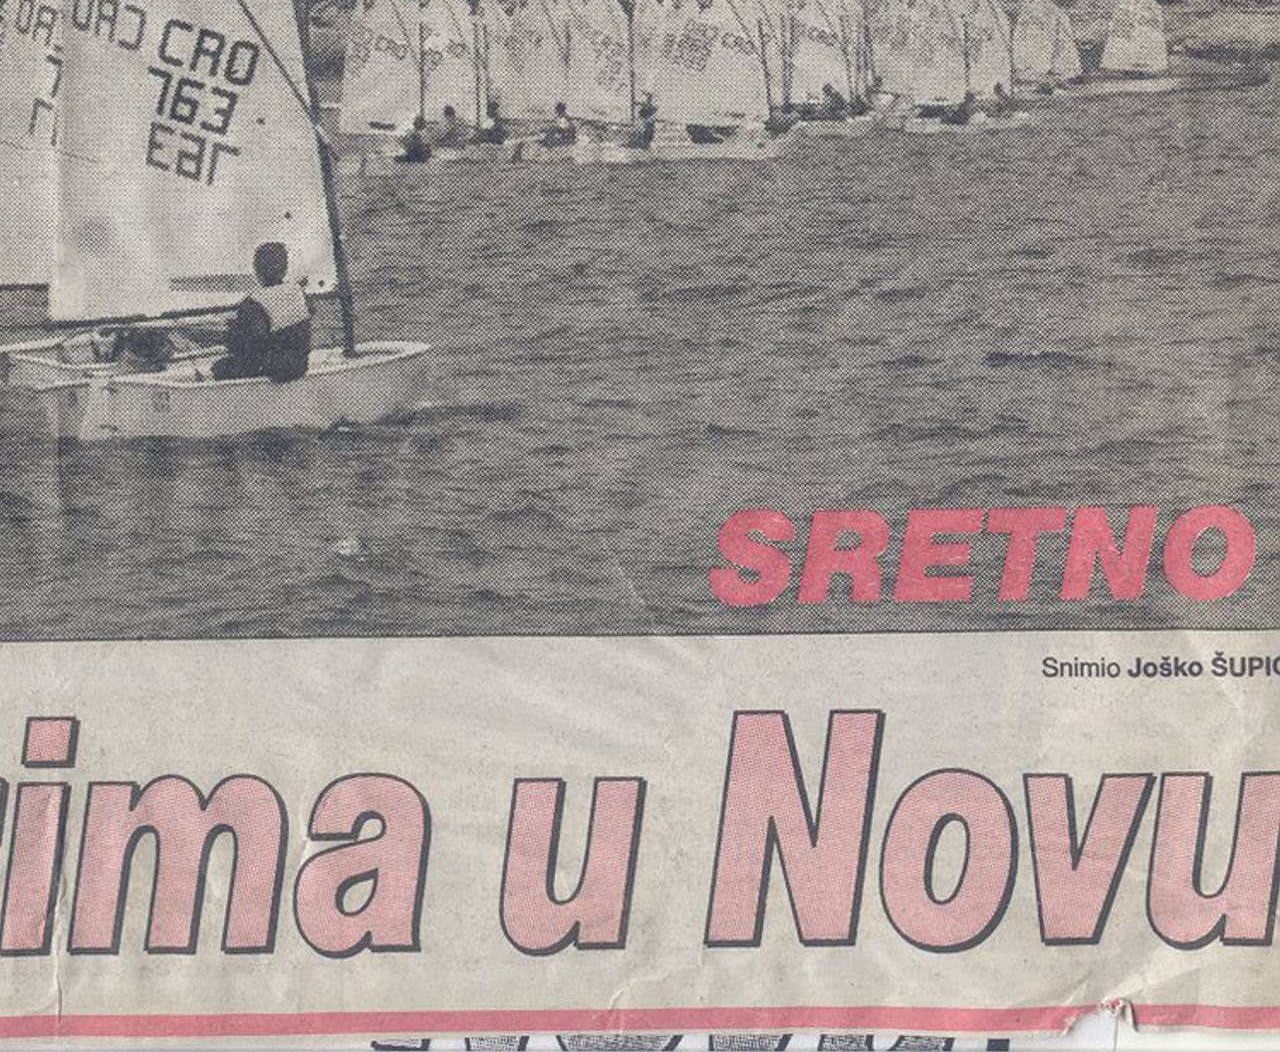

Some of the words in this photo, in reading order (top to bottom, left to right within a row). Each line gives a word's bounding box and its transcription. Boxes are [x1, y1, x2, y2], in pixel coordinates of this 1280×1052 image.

[158, 18, 262, 87] CRO
[147, 65, 240, 137] 763
[708, 505, 1256, 607] SRETNO
[1042, 656, 1121, 678] Snimio
[1128, 656, 1203, 678] Joško
[499, 776, 648, 957] u
[704, 708, 1280, 954] Novu
